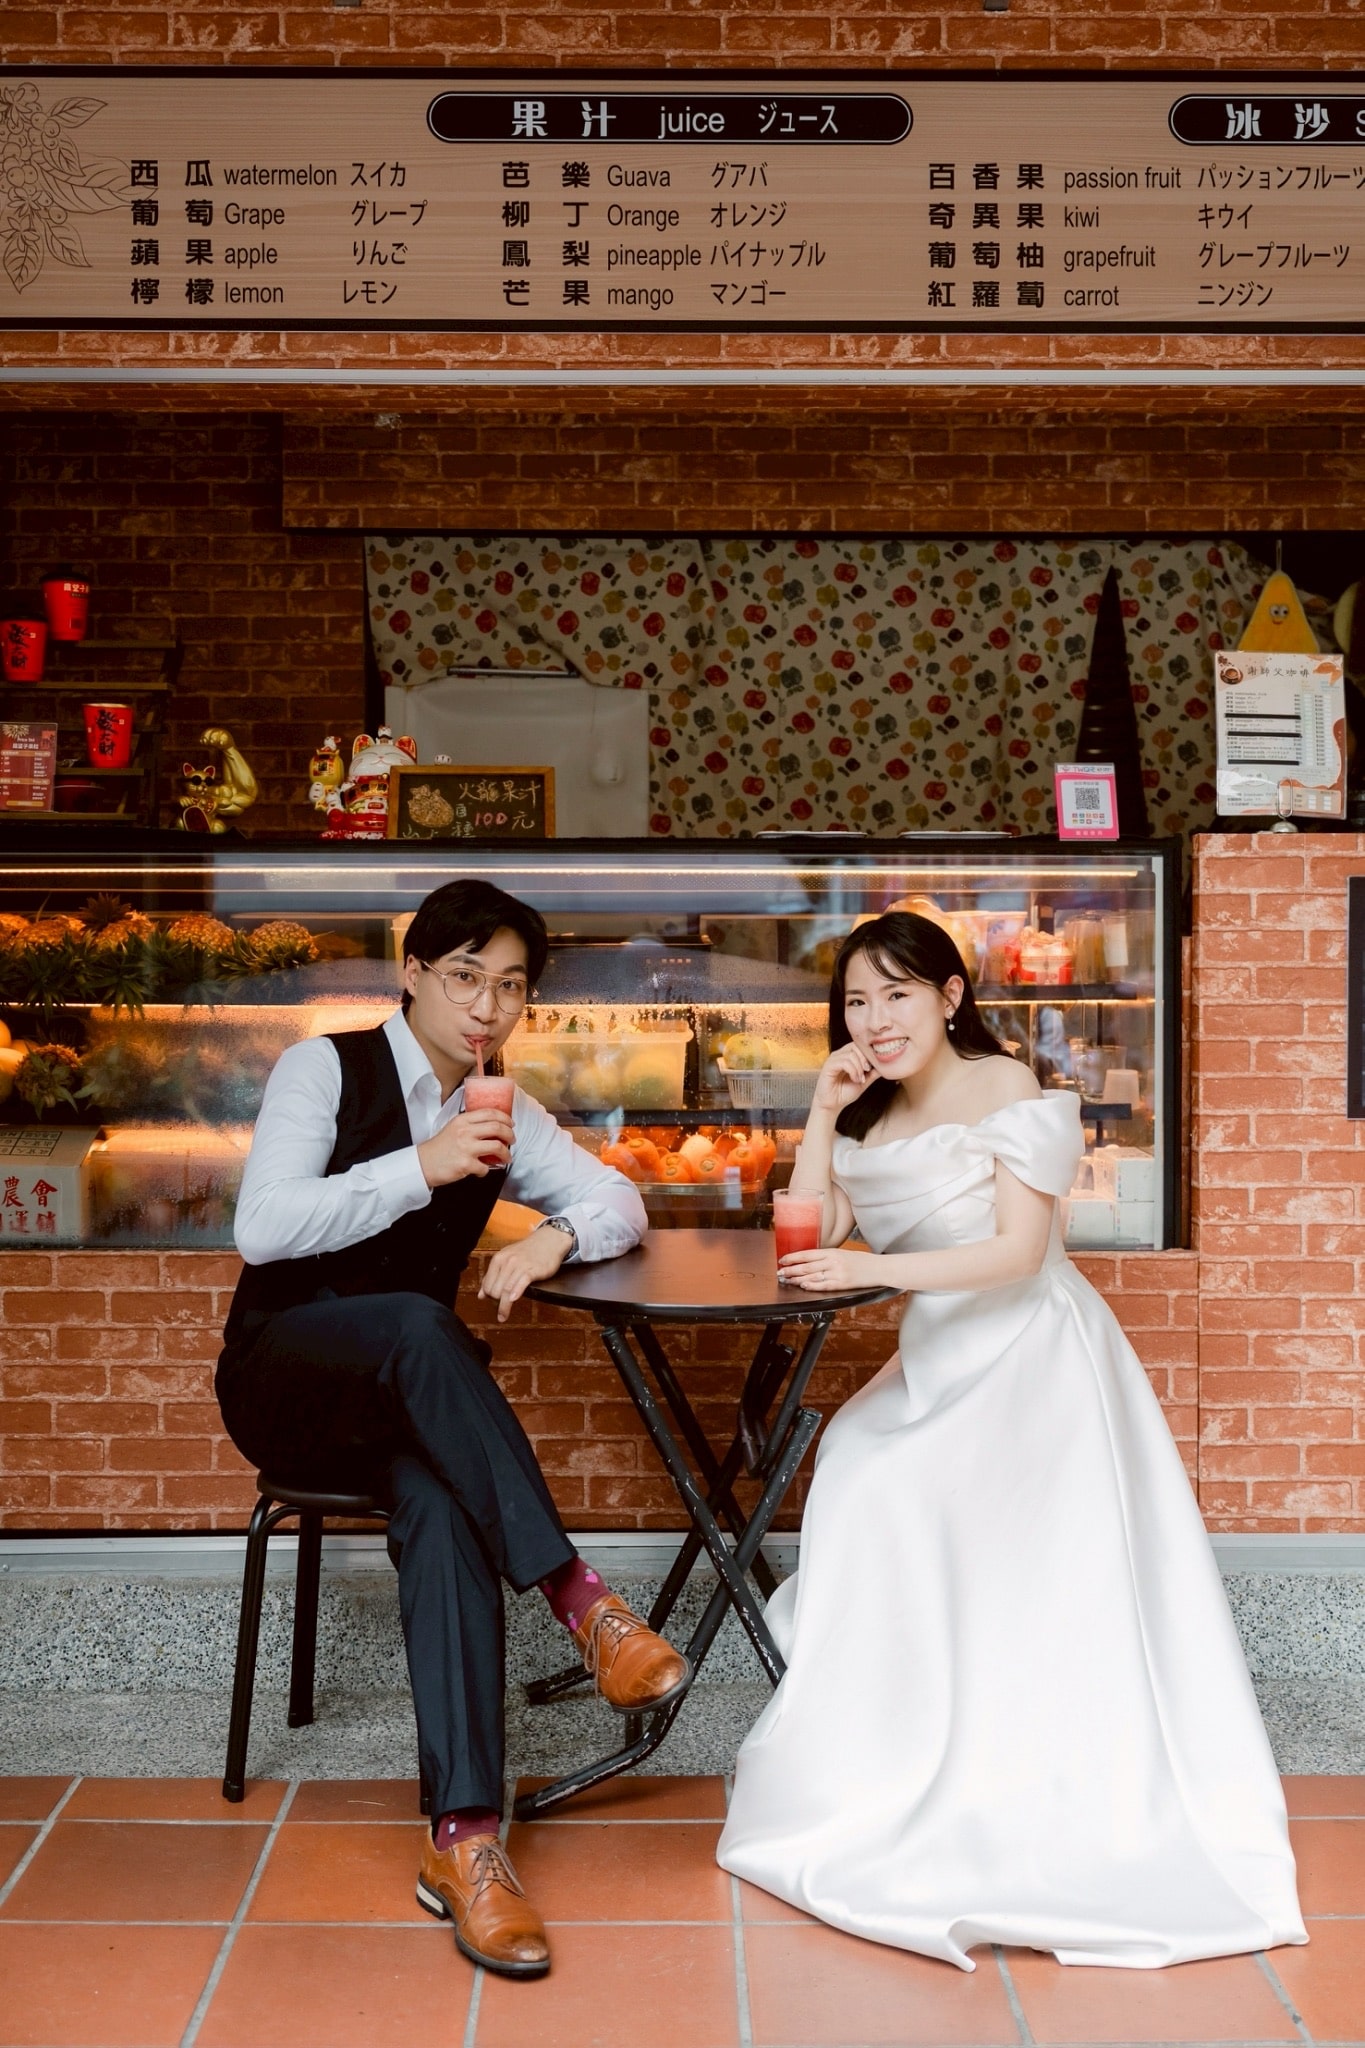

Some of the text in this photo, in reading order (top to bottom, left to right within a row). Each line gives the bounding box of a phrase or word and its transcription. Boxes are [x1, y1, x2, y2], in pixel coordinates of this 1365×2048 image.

[511, 100, 840, 140] 果汁 juice ジュース
[1224, 103, 1331, 140] 冰沙
[130, 160, 406, 189] 西瓜 watermelon スイカ
[501, 160, 769, 189] 芭樂 Guava グアバ
[928, 162, 1045, 191] 百香果
[1064, 166, 1138, 194] passion
[1144, 166, 1182, 189] fruit
[130, 198, 428, 230] 葡萄 Grape グレープ
[501, 200, 787, 231] 柳丁 Orange オレンジ
[928, 202, 1253, 230] 奇異果 kiwi キウイ
[130, 238, 408, 269] 蘋果 apple りんご
[501, 239, 826, 270] 鳳梨 pineapple パイナップル
[928, 240, 1350, 273] 葡萄柚 grapefruit グレープフルーツ
[130, 277, 398, 306] 檸檬 lemon レモン
[502, 279, 787, 311] 芒果 mango マンゴー
[927, 280, 1273, 309] 紅蘿蔔 carrot ニンジン
